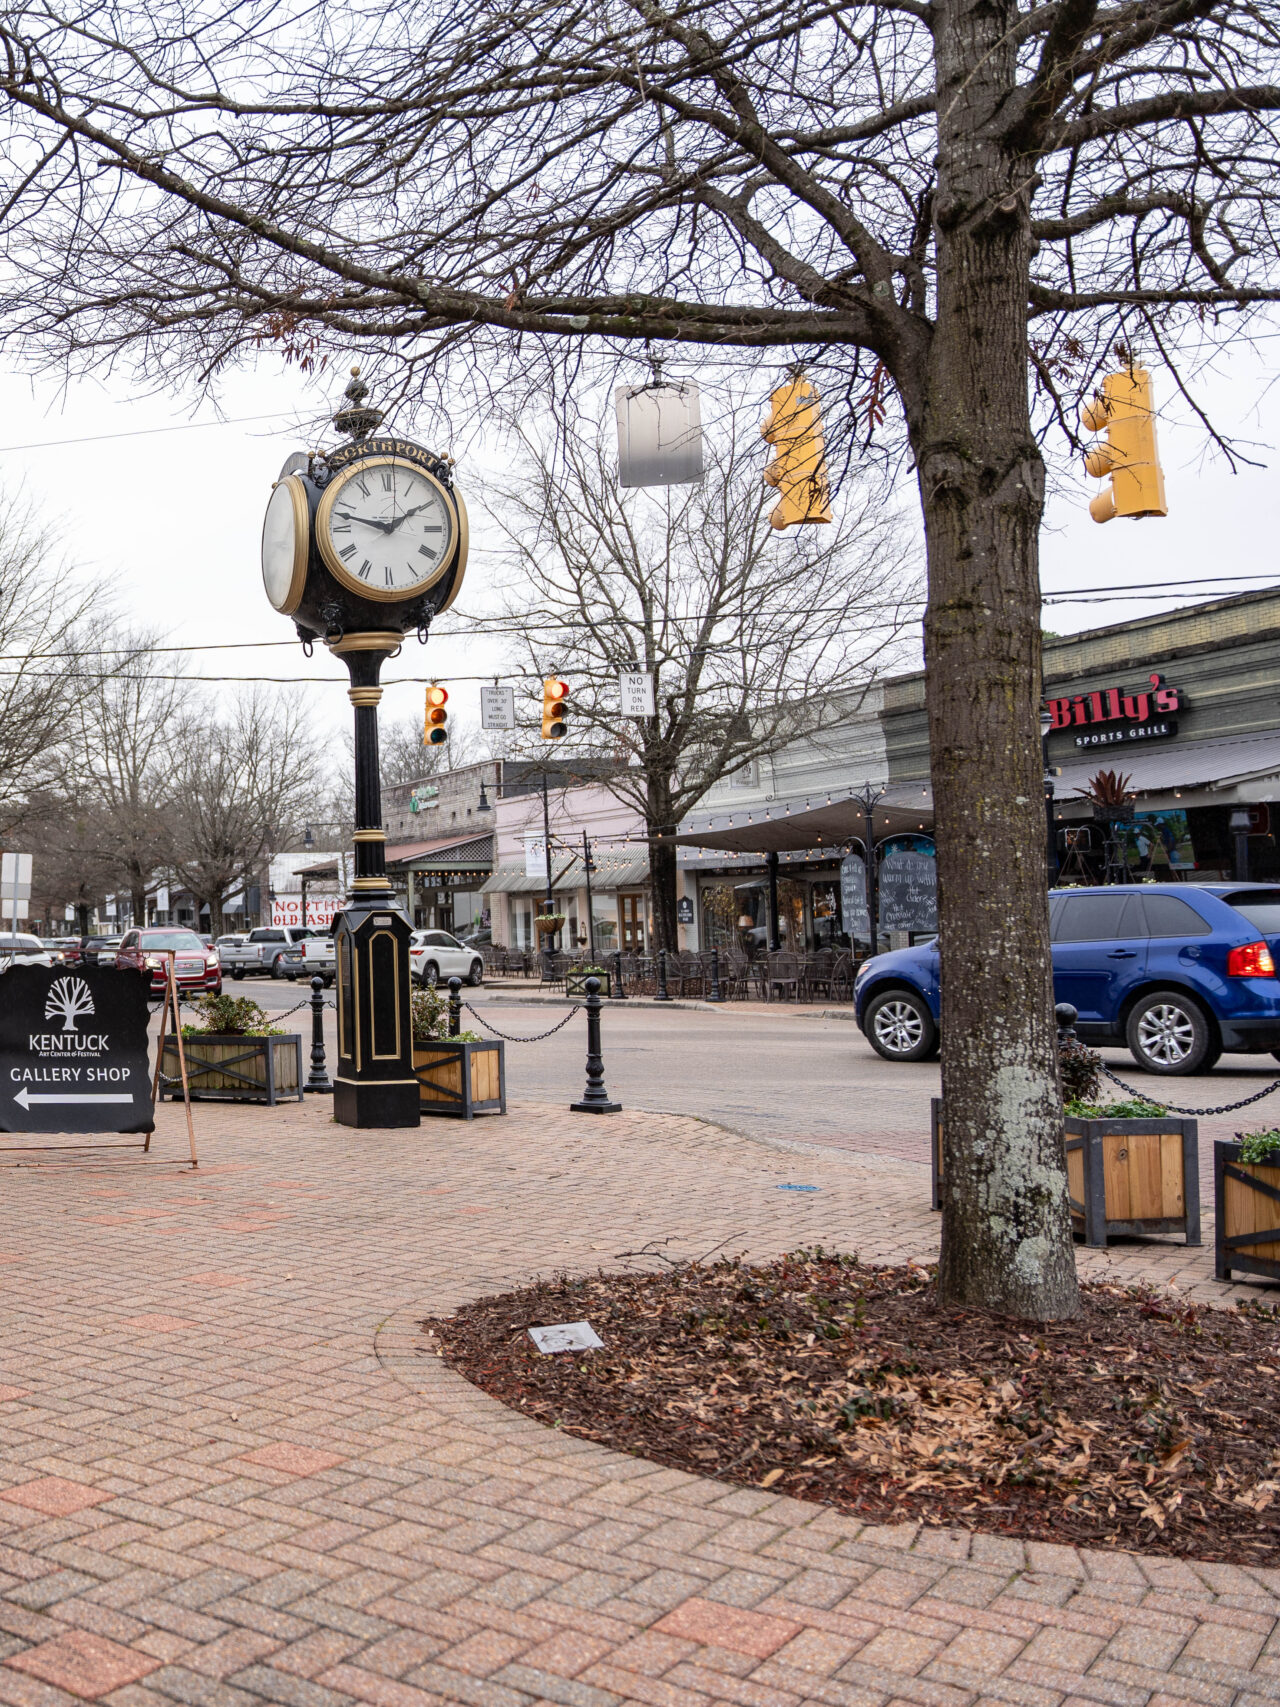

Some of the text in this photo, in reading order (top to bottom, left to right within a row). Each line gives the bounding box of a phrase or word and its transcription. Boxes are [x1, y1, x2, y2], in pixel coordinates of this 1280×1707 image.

[332, 441, 438, 468] NORTHPORT
[629, 676, 643, 685] NO
[1046, 673, 1179, 730] Billy's
[1076, 724, 1167, 746] SPORTS GRILL
[273, 914, 298, 926] OLD
[29, 1034, 110, 1051] KENTUCK
[10, 1067, 131, 1082] GALLERY SHOP
